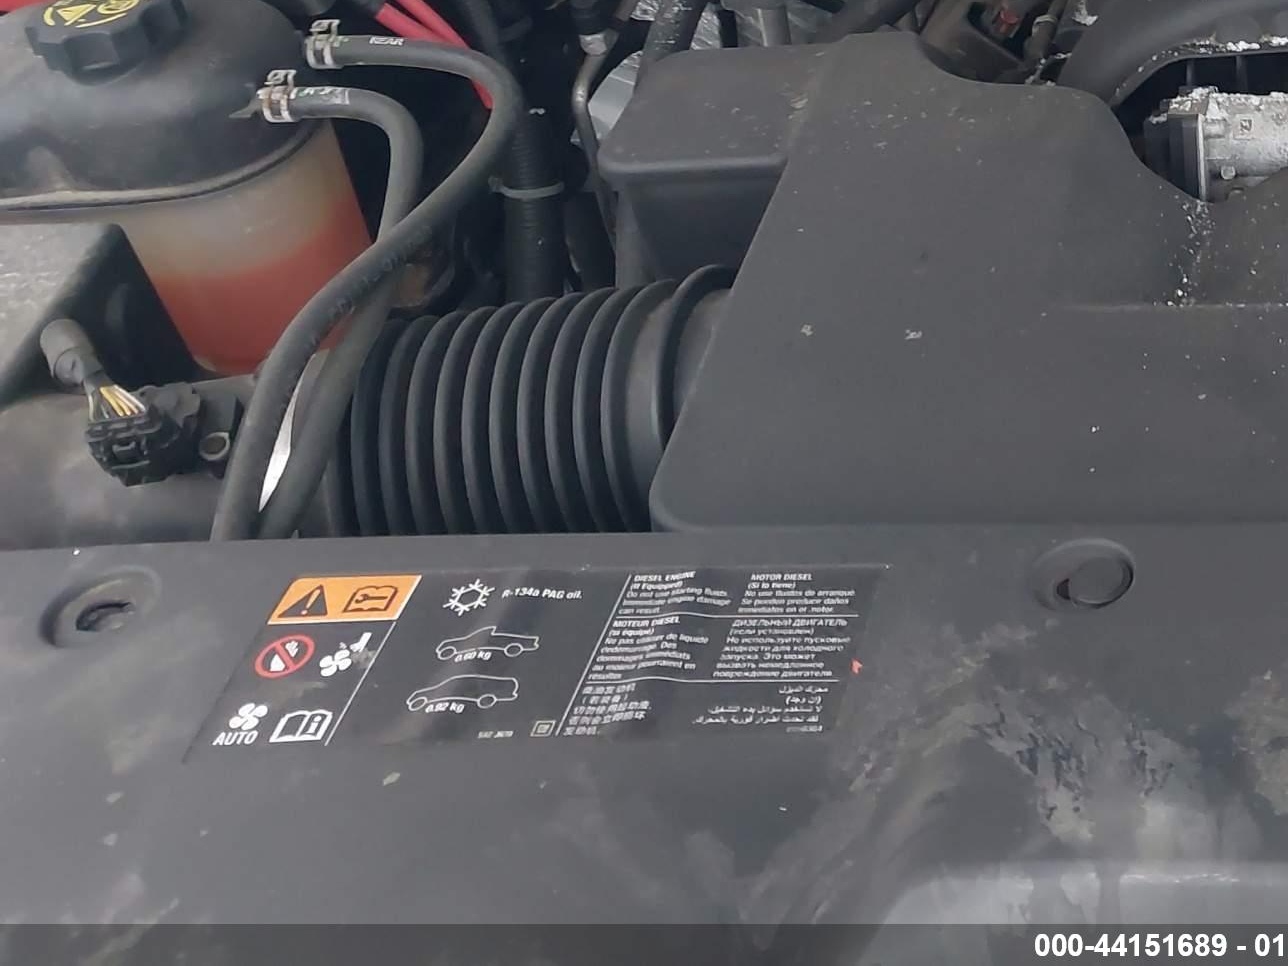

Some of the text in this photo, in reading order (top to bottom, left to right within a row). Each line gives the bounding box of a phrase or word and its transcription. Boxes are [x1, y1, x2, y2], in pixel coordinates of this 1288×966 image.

[634, 574, 662, 582] DIESEL
[750, 573, 812, 581] MOTOR DIESEL
[541, 589, 564, 599] PAG
[612, 620, 650, 628] MOTEUR
[792, 618, 848, 627] ДВИГАТЕЛЬ
[212, 730, 259, 745] AUTO
